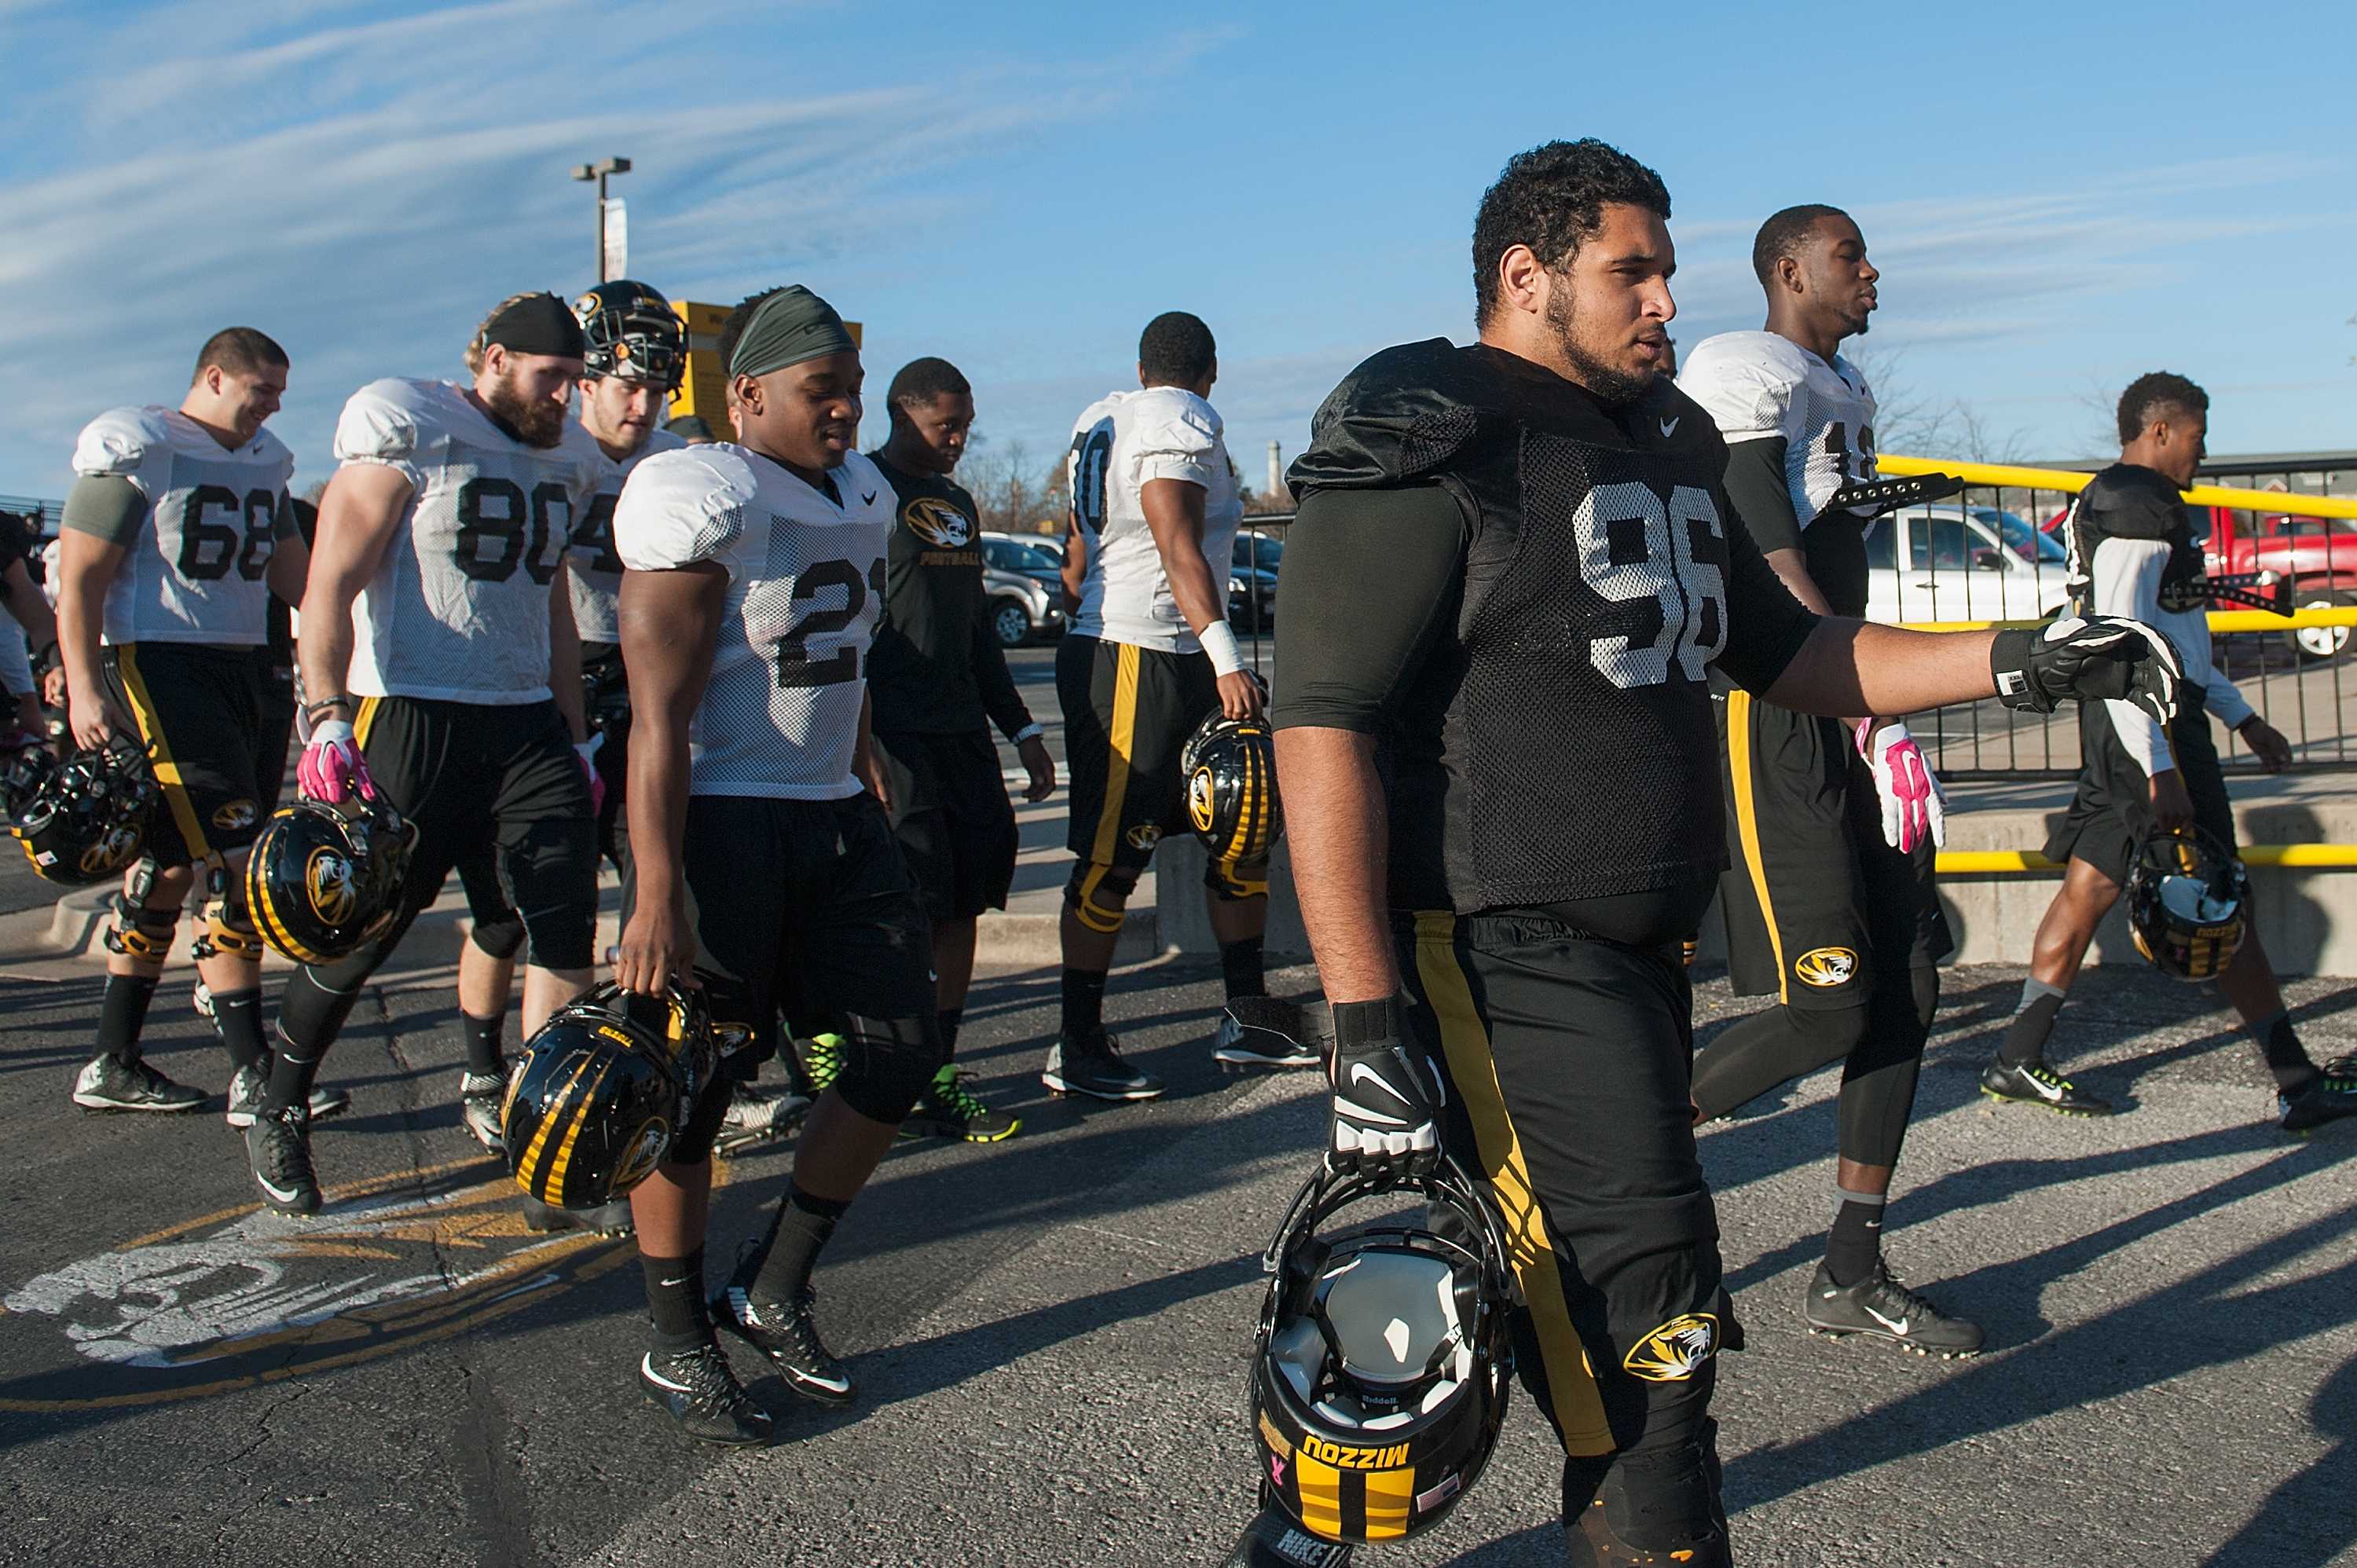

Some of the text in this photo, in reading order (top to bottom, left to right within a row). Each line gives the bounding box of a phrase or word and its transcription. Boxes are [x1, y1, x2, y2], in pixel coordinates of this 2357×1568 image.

[177, 484, 275, 581] 68
[455, 478, 572, 585] 80
[1572, 481, 1728, 690] 96
[1362, 1394, 1398, 1405] Riddell
[1303, 1434, 1410, 1469] MIZZOU
